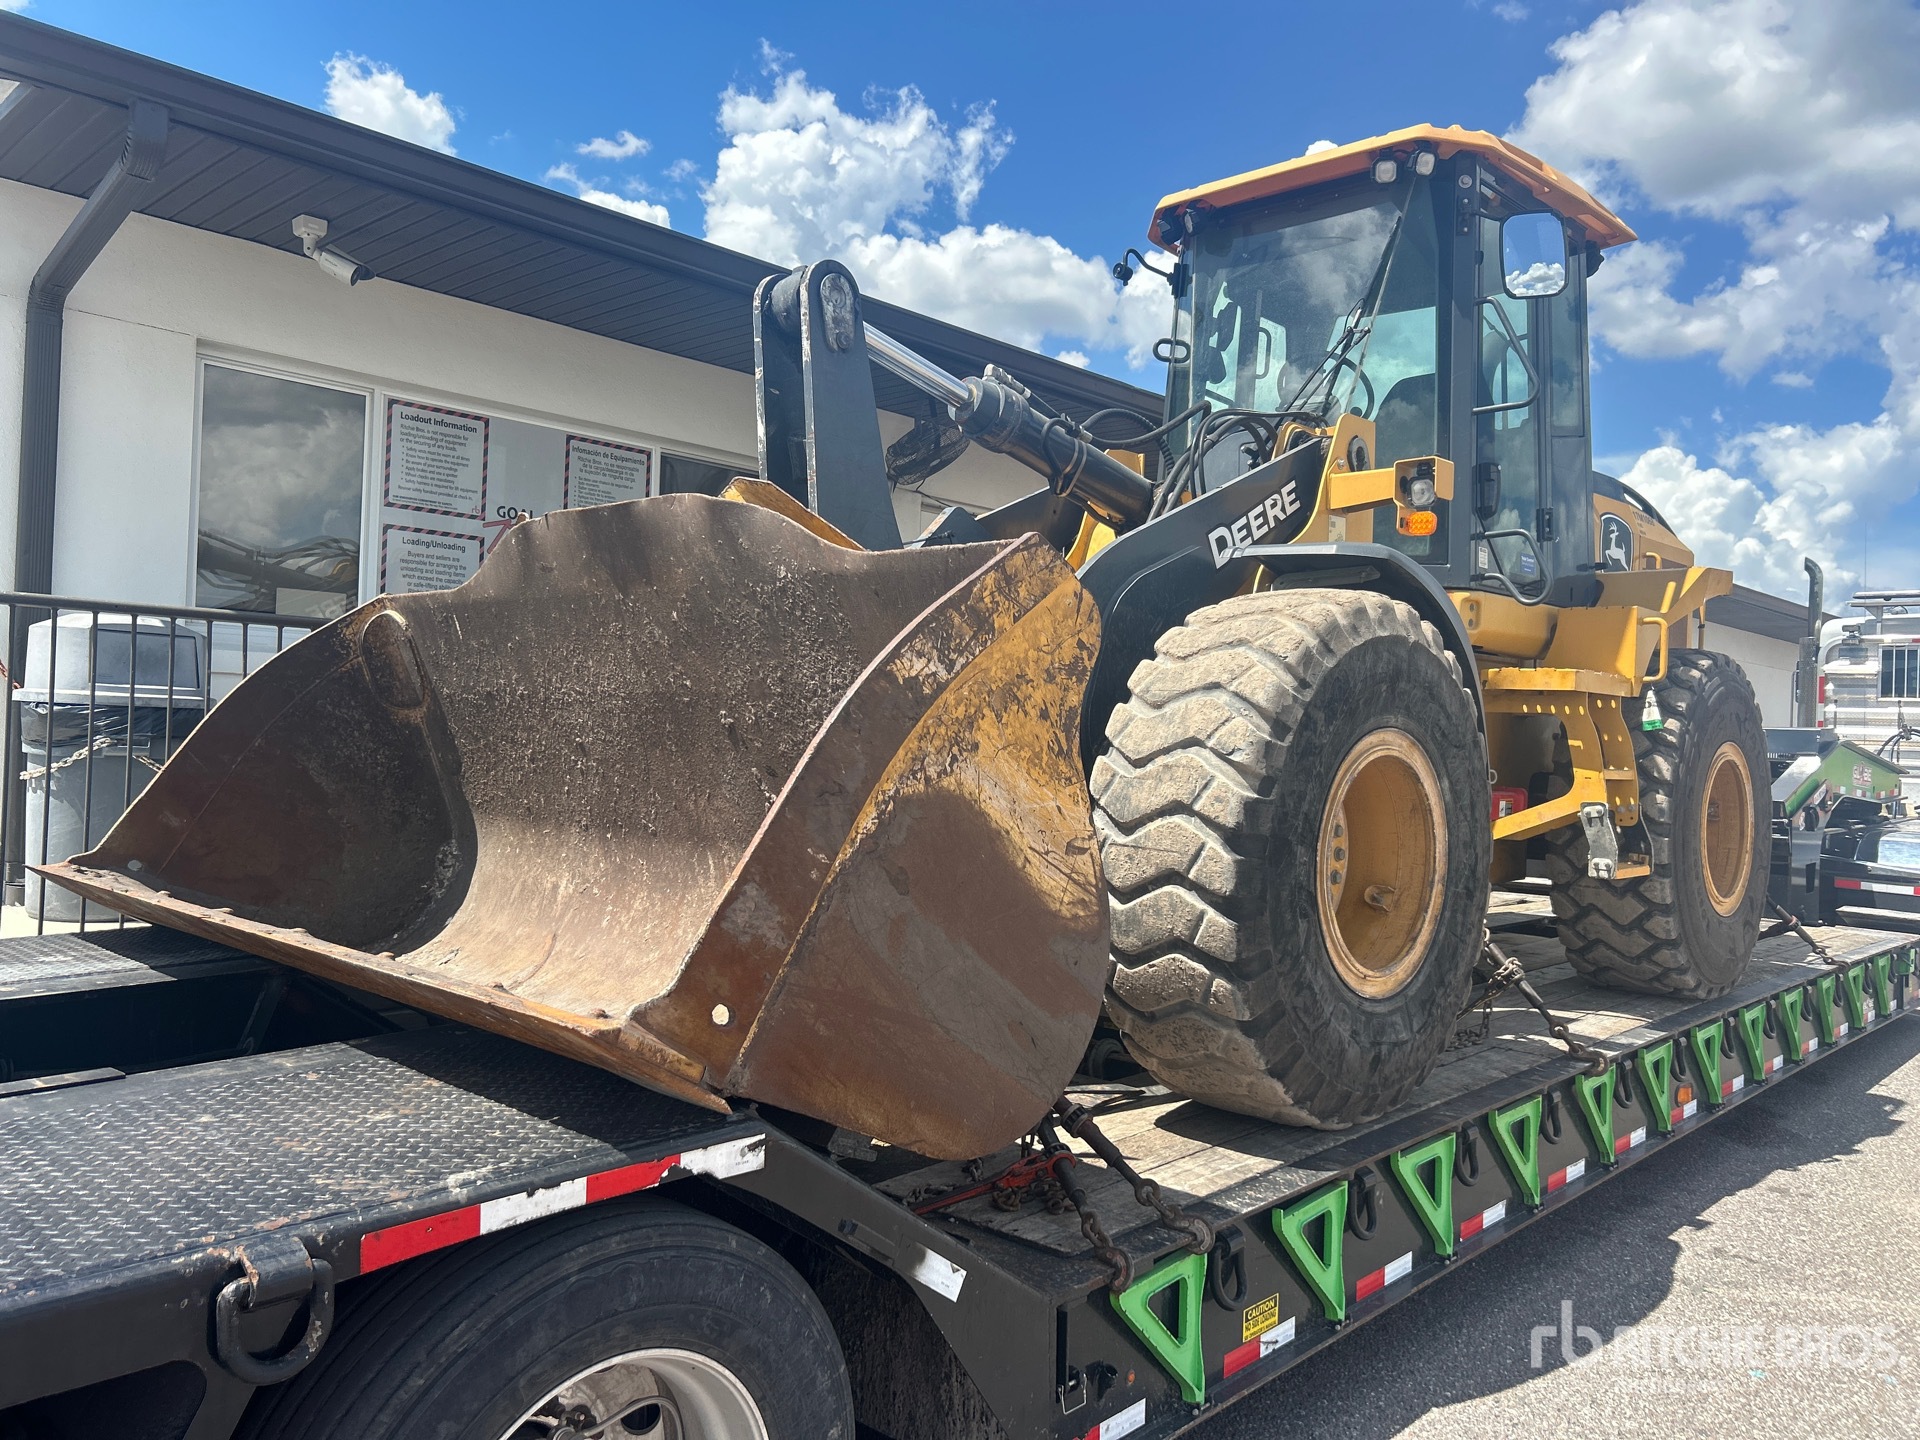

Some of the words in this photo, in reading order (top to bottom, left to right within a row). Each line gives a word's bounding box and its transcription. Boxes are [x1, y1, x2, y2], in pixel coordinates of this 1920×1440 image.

[400, 412, 431, 424] Loadout
[434, 418, 477, 433] Information
[1208, 480, 1301, 569] DEERE
[402, 536, 466, 554] Loading/Unloading
[407, 551, 424, 559] Buyers
[399, 557, 427, 567] responsible
[1248, 1299, 1274, 1319] CAUTION
[1245, 1322, 1250, 1332] NO
[1260, 1309, 1276, 1324] LOADING
